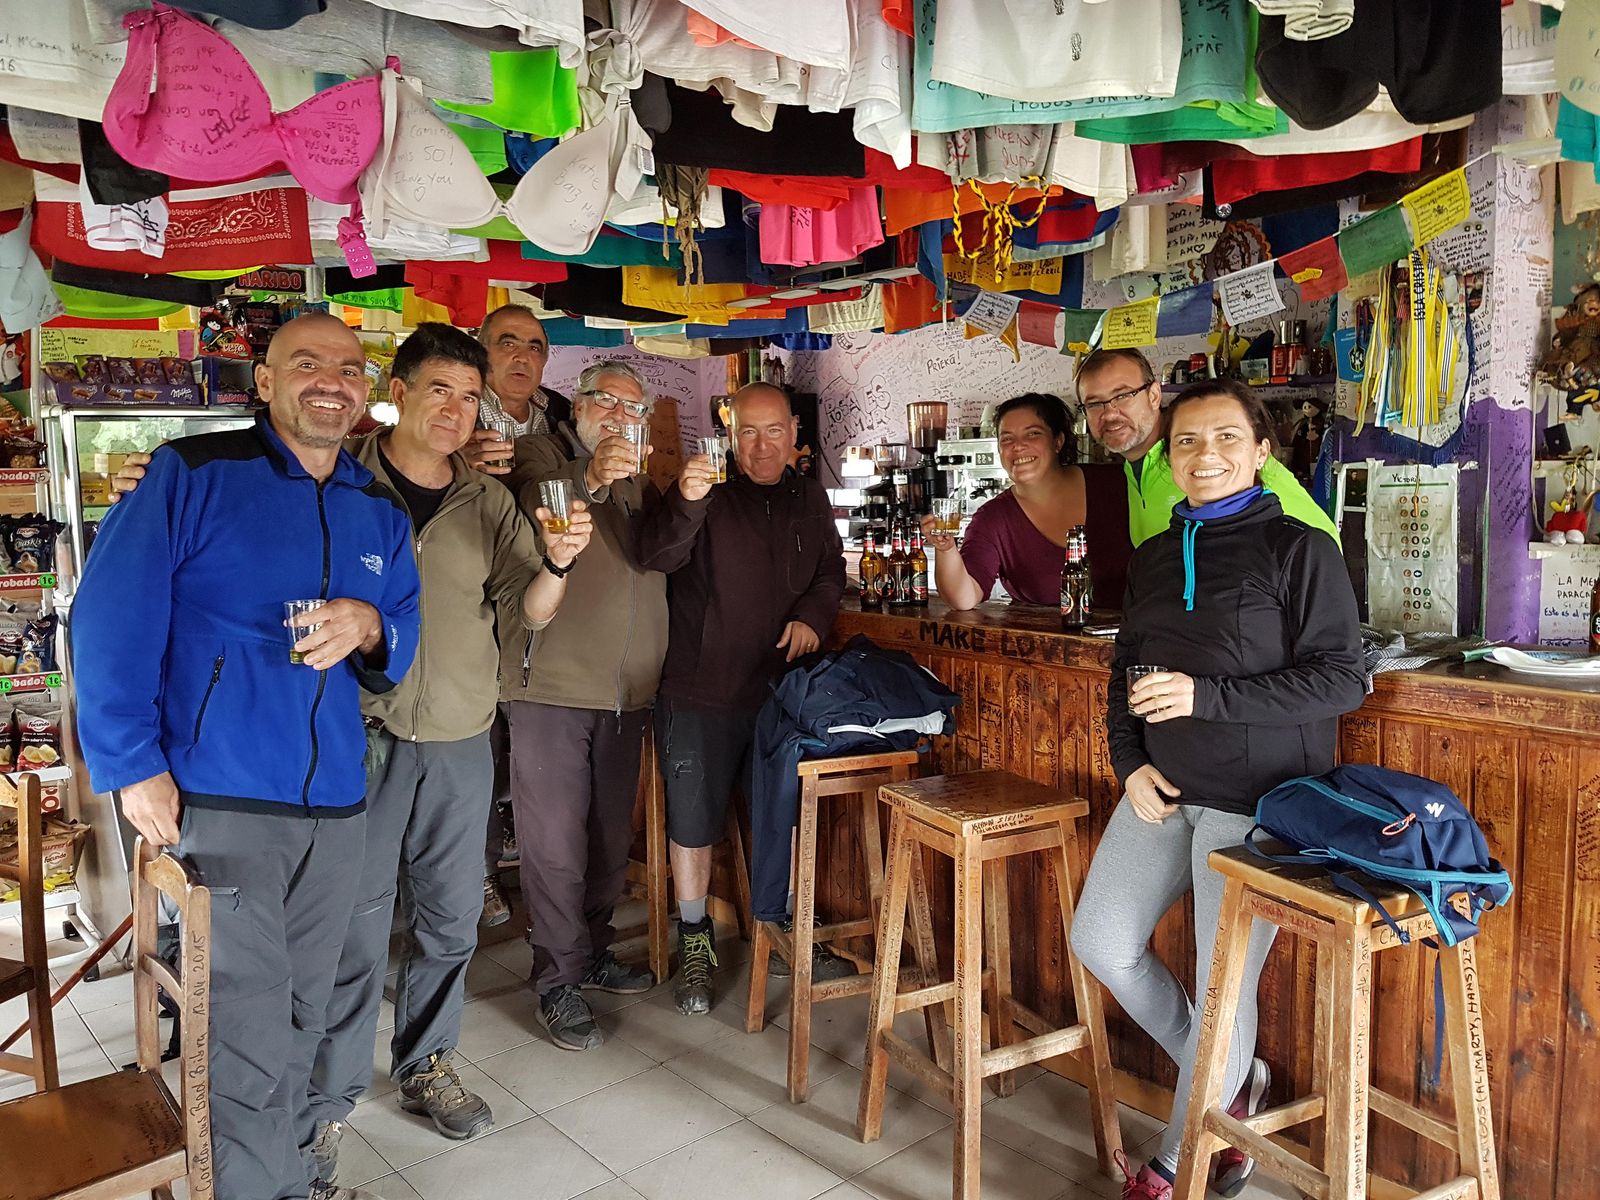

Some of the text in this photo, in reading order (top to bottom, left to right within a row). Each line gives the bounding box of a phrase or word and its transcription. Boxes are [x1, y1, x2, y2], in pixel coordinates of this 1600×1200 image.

[427, 171, 452, 185] You
[239, 270, 302, 290] HARIBO
[1413, 296, 1425, 320] ISLA
[170, 388, 192, 399] Milka
[1558, 576, 1572, 586] LA
[919, 620, 986, 653] MAKE
[188, 1080, 210, 1116] Bad
[197, 1115, 209, 1138] aus
